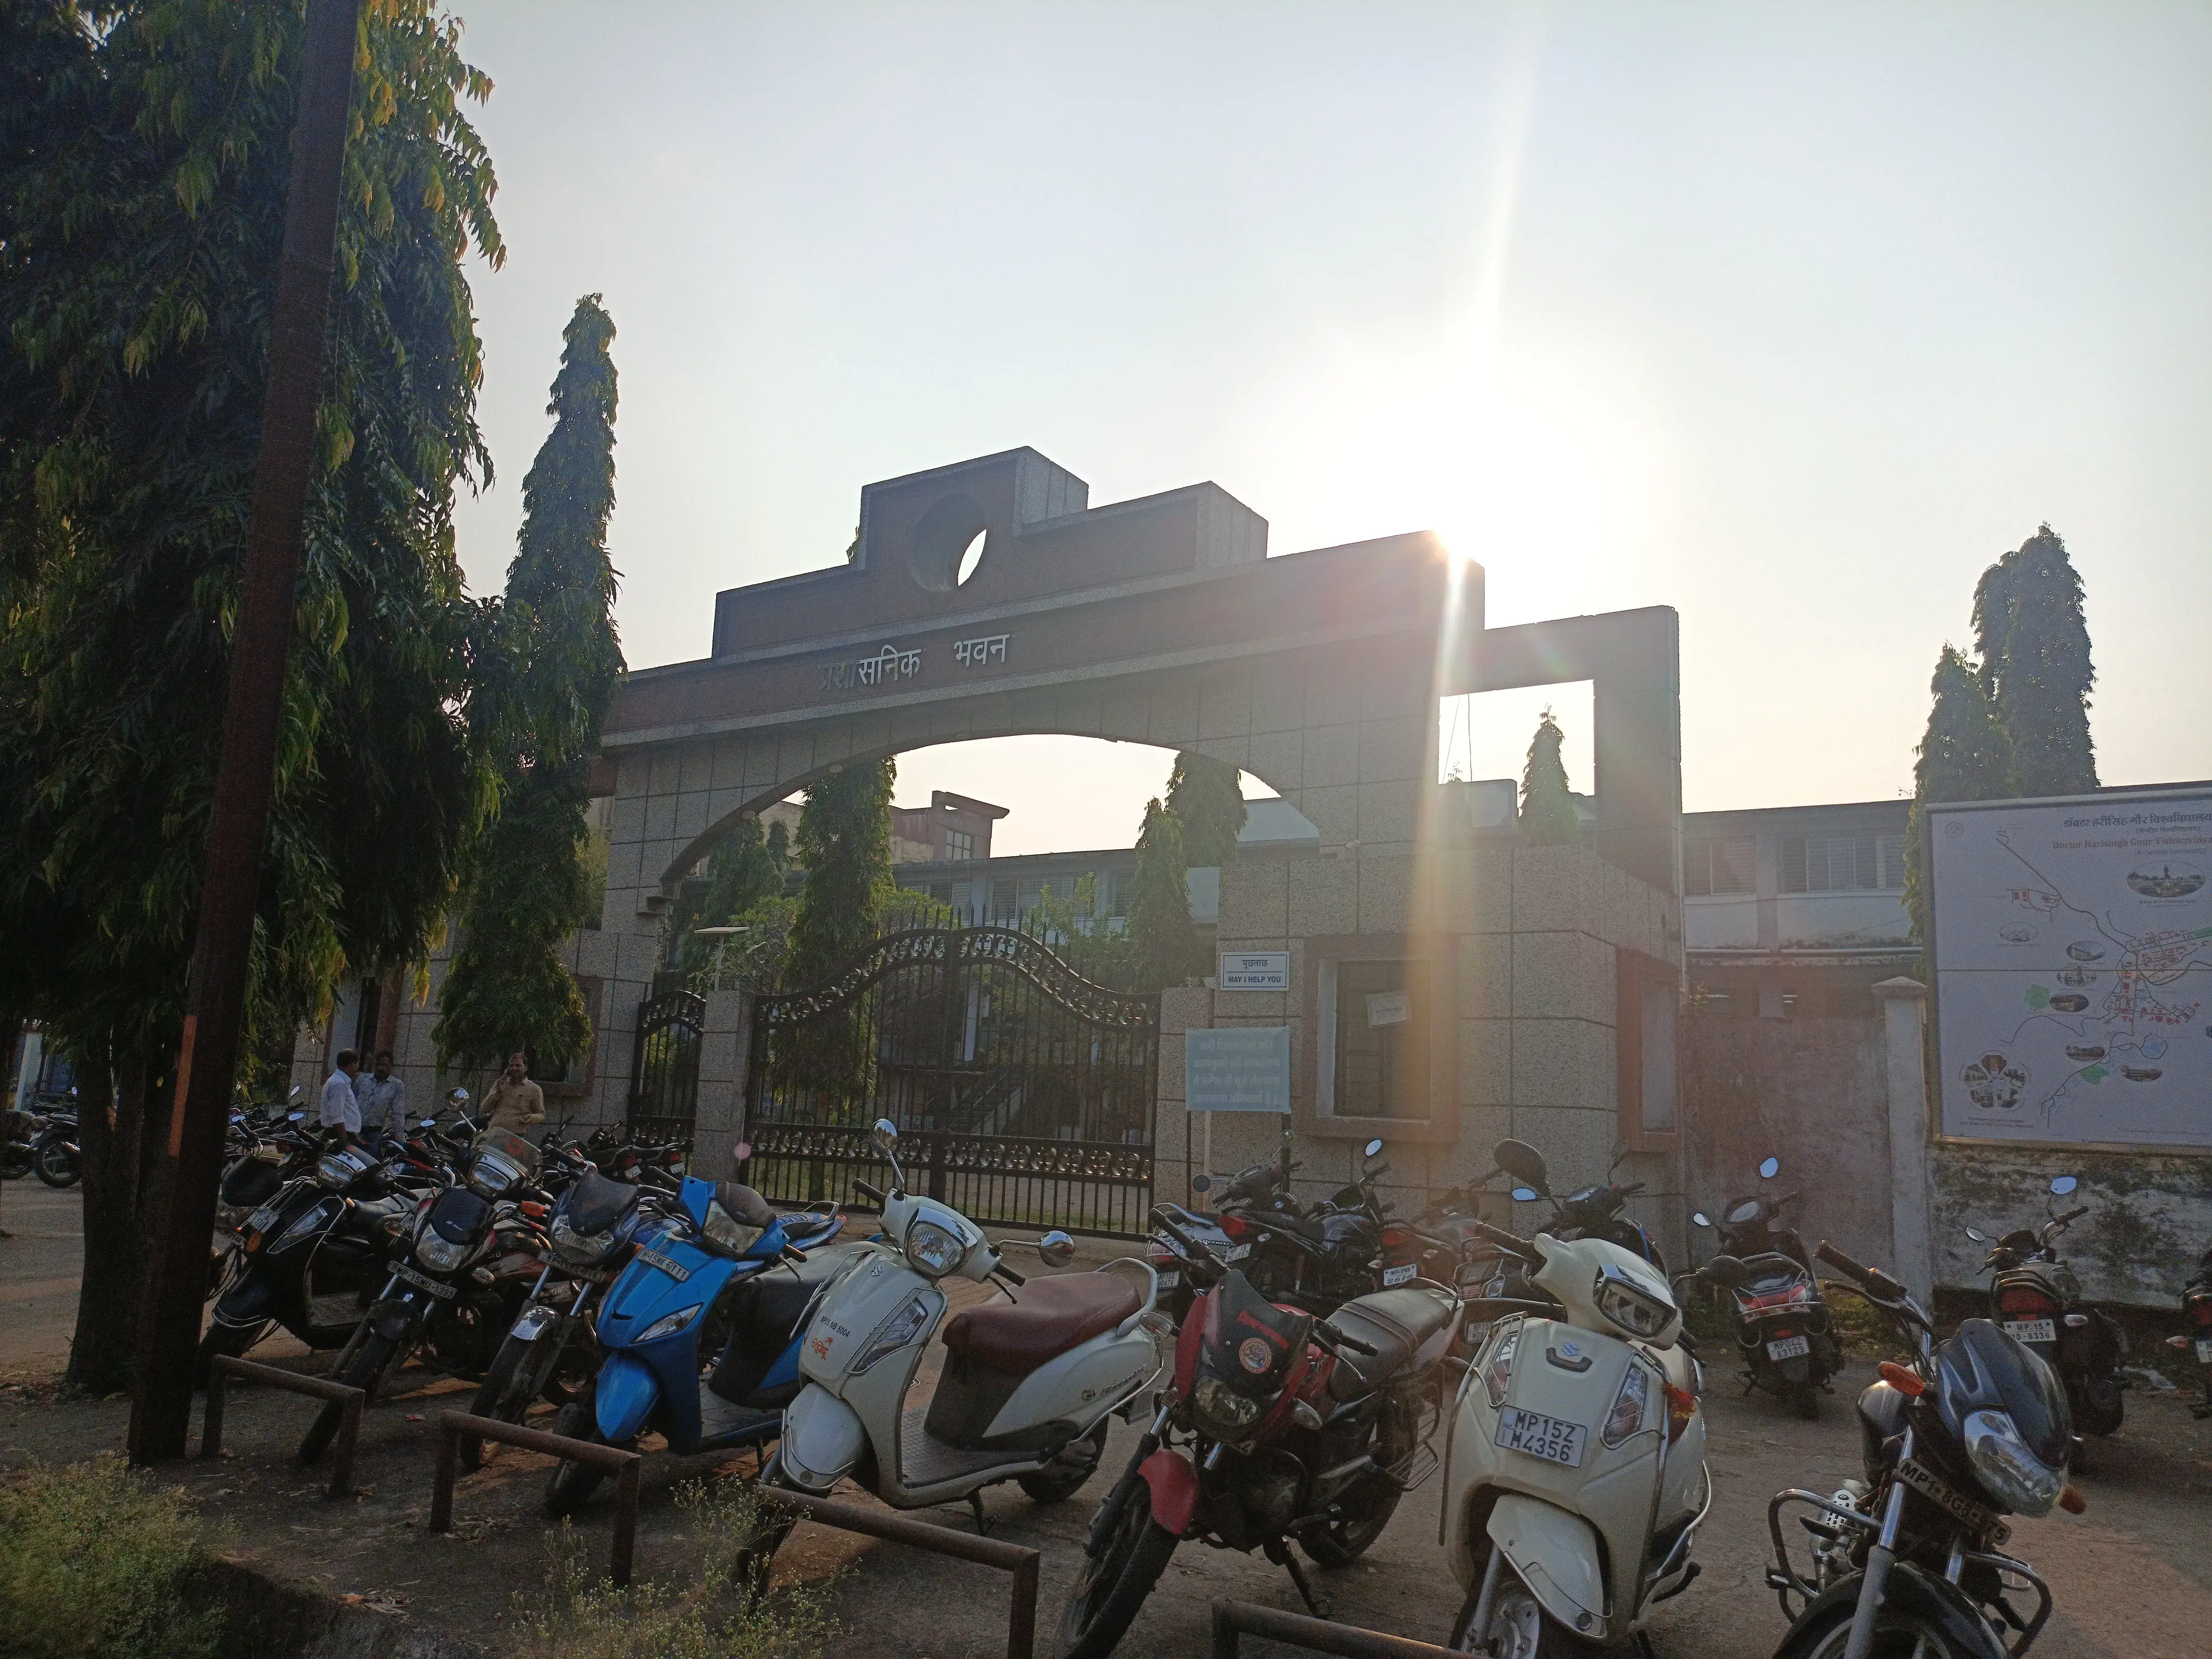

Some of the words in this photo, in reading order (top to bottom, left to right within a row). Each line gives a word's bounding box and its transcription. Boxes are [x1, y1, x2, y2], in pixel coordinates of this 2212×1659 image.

[953, 634, 1010, 667] भवन
[2129, 814, 2147, 824] गौर
[2084, 839, 2128, 849] Harisingh
[1242, 959, 1268, 970] पूछताछ
[820, 1316, 831, 1326] MP15
[829, 1321, 838, 1330] NB
[836, 1325, 851, 1338] 5004
[1515, 1411, 1577, 1444] MP15Z
[1509, 1429, 1571, 1462] M4356
